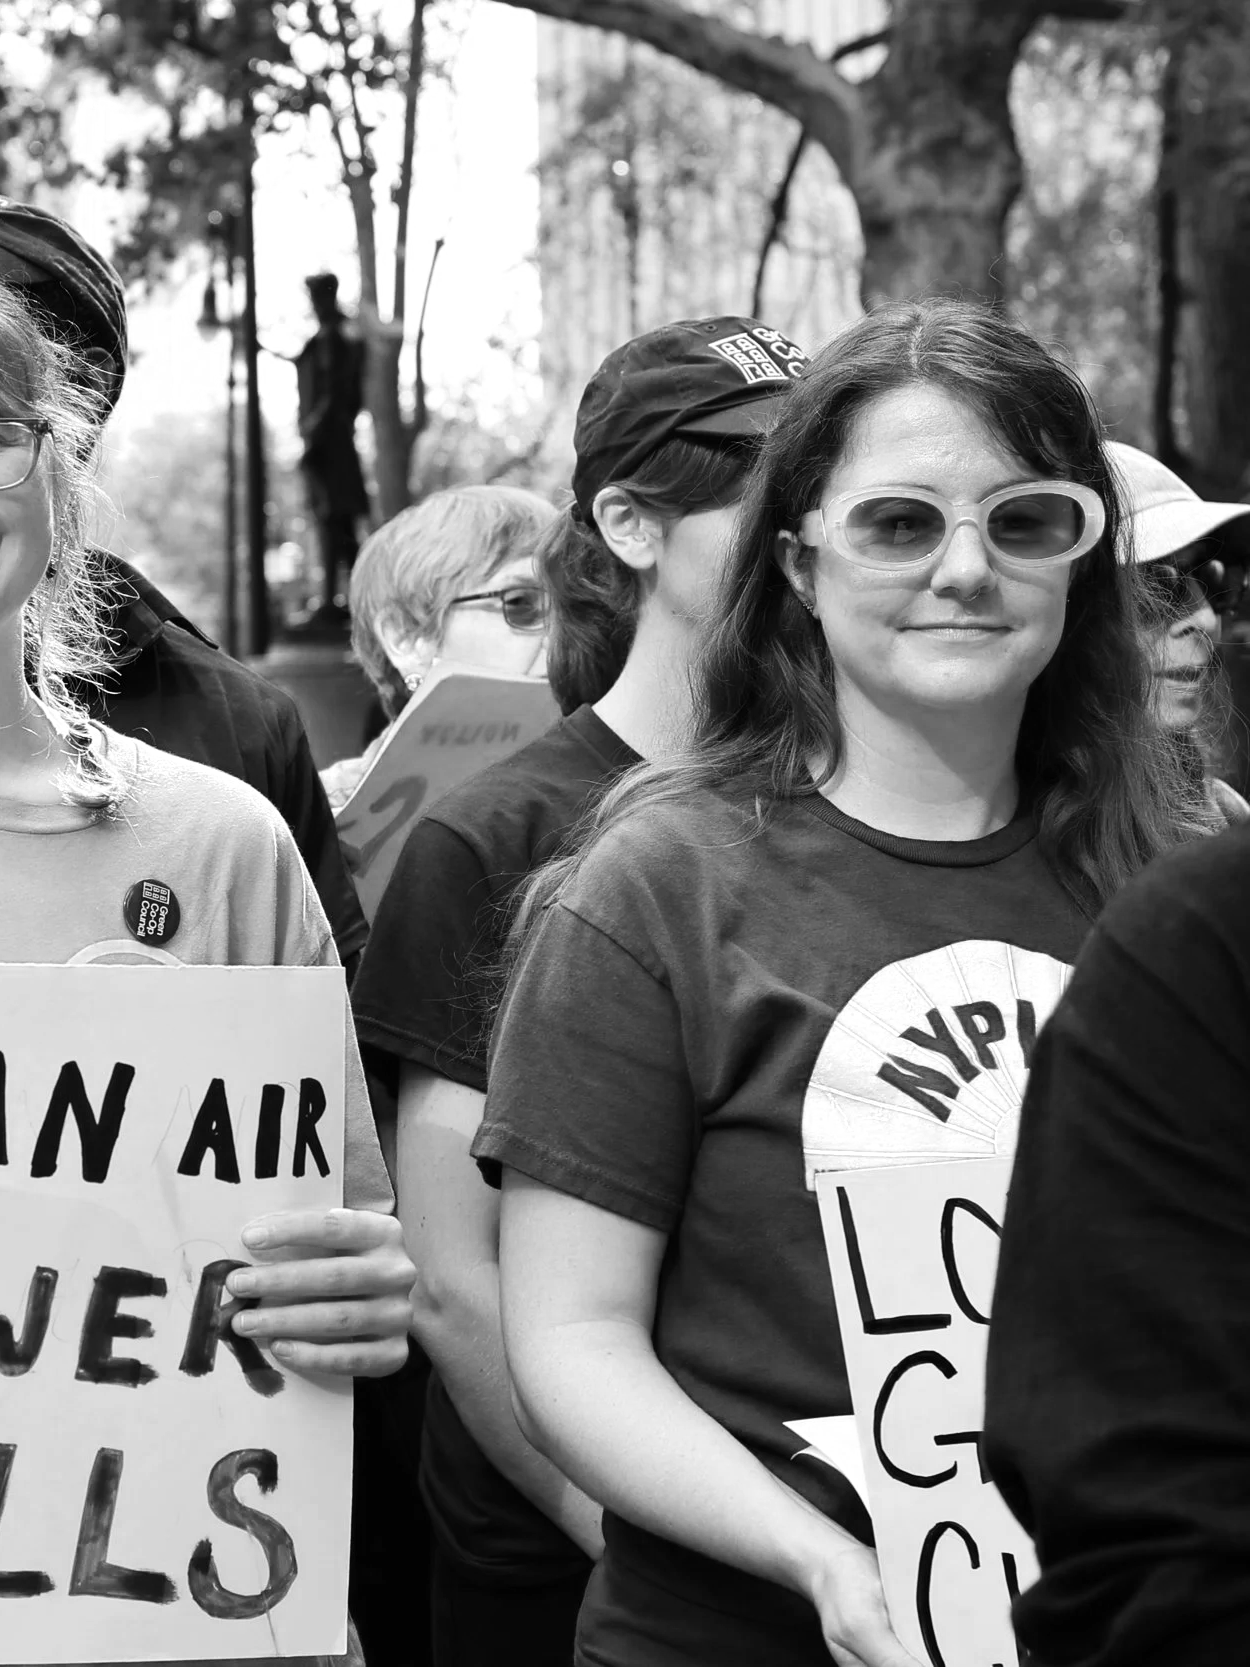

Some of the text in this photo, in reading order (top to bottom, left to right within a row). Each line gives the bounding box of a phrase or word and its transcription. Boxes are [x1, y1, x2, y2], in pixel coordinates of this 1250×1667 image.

[136, 900, 150, 937] Council
[146, 902, 159, 935] Co-Op
[156, 905, 169, 936] Green
[177, 1077, 331, 1184] AIR
